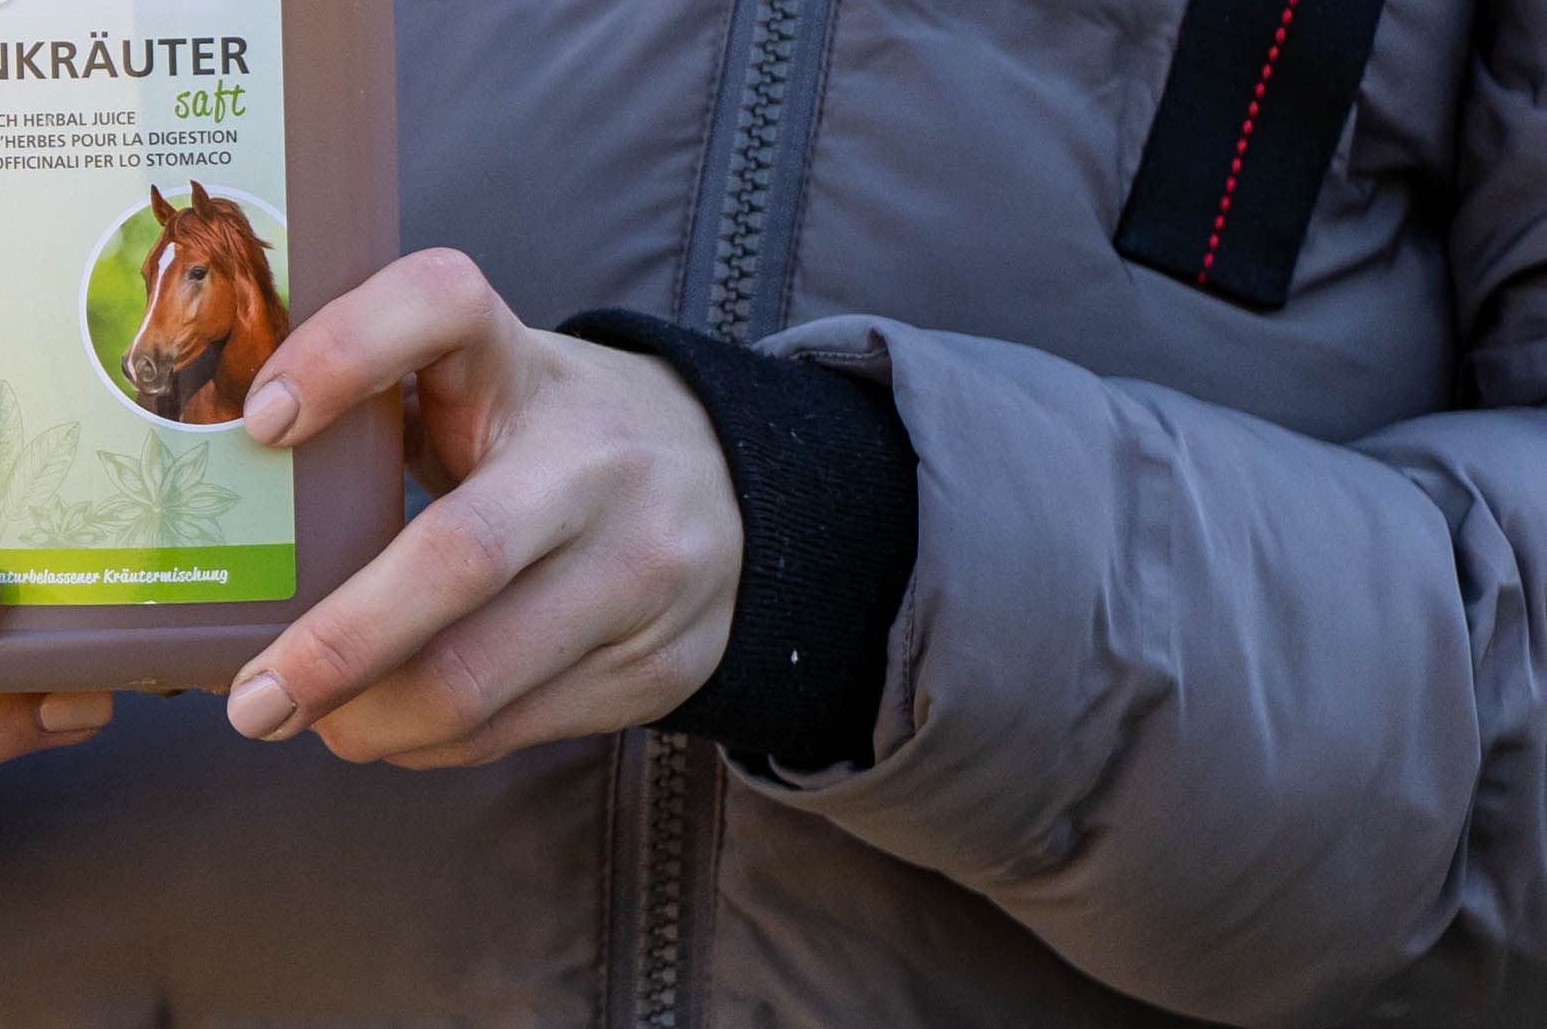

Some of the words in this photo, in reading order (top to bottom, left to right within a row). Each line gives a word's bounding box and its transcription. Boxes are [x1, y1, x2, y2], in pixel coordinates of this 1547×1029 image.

[175, 78, 246, 122] saft
[22, 111, 87, 128] HERBAL
[91, 110, 136, 127] JUICE
[71, 132, 118, 148] POUR
[122, 131, 144, 146] LA
[149, 130, 238, 147] DIGESTION
[84, 153, 115, 170] PER
[119, 153, 141, 169] LO
[146, 151, 232, 168] STOMACO
[103, 568, 228, 584] Kräutermischung
